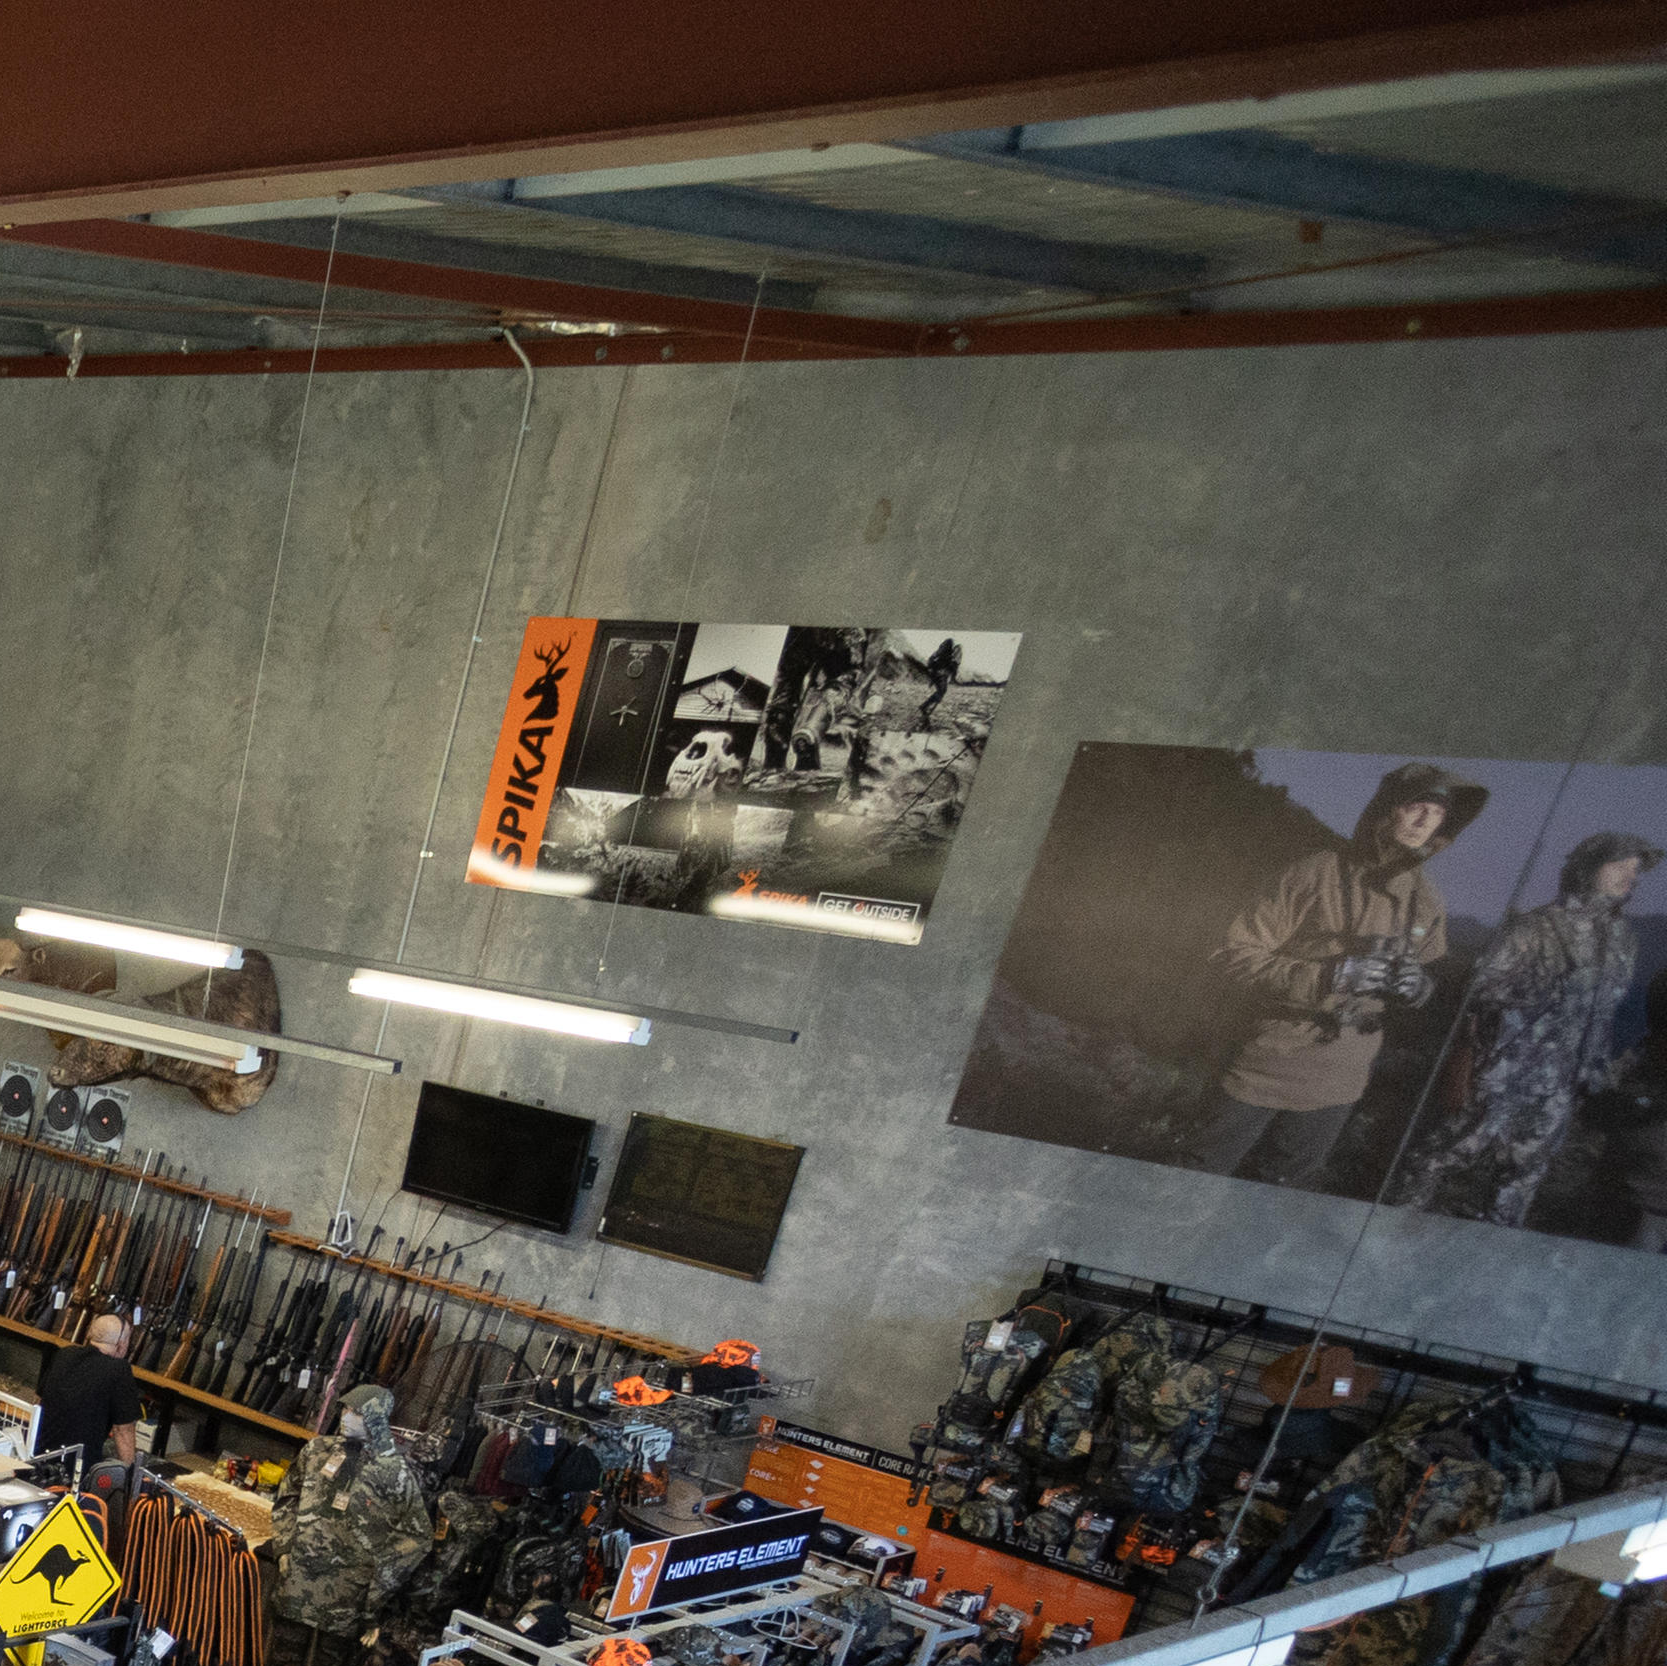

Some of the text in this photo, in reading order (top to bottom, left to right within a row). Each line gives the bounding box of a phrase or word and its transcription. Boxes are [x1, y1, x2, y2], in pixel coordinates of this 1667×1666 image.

[490, 722, 555, 872] SPIKA
[823, 900, 912, 921] GET OUTSIDE
[777, 1425, 904, 1474] HUNTERS ELEMENT CORE
[666, 1550, 736, 1580] HUNTERS
[736, 1535, 810, 1567] ELEMENT
[13, 1619, 68, 1634] LIGHTFORCE
[21, 1611, 54, 1621] Welcome
